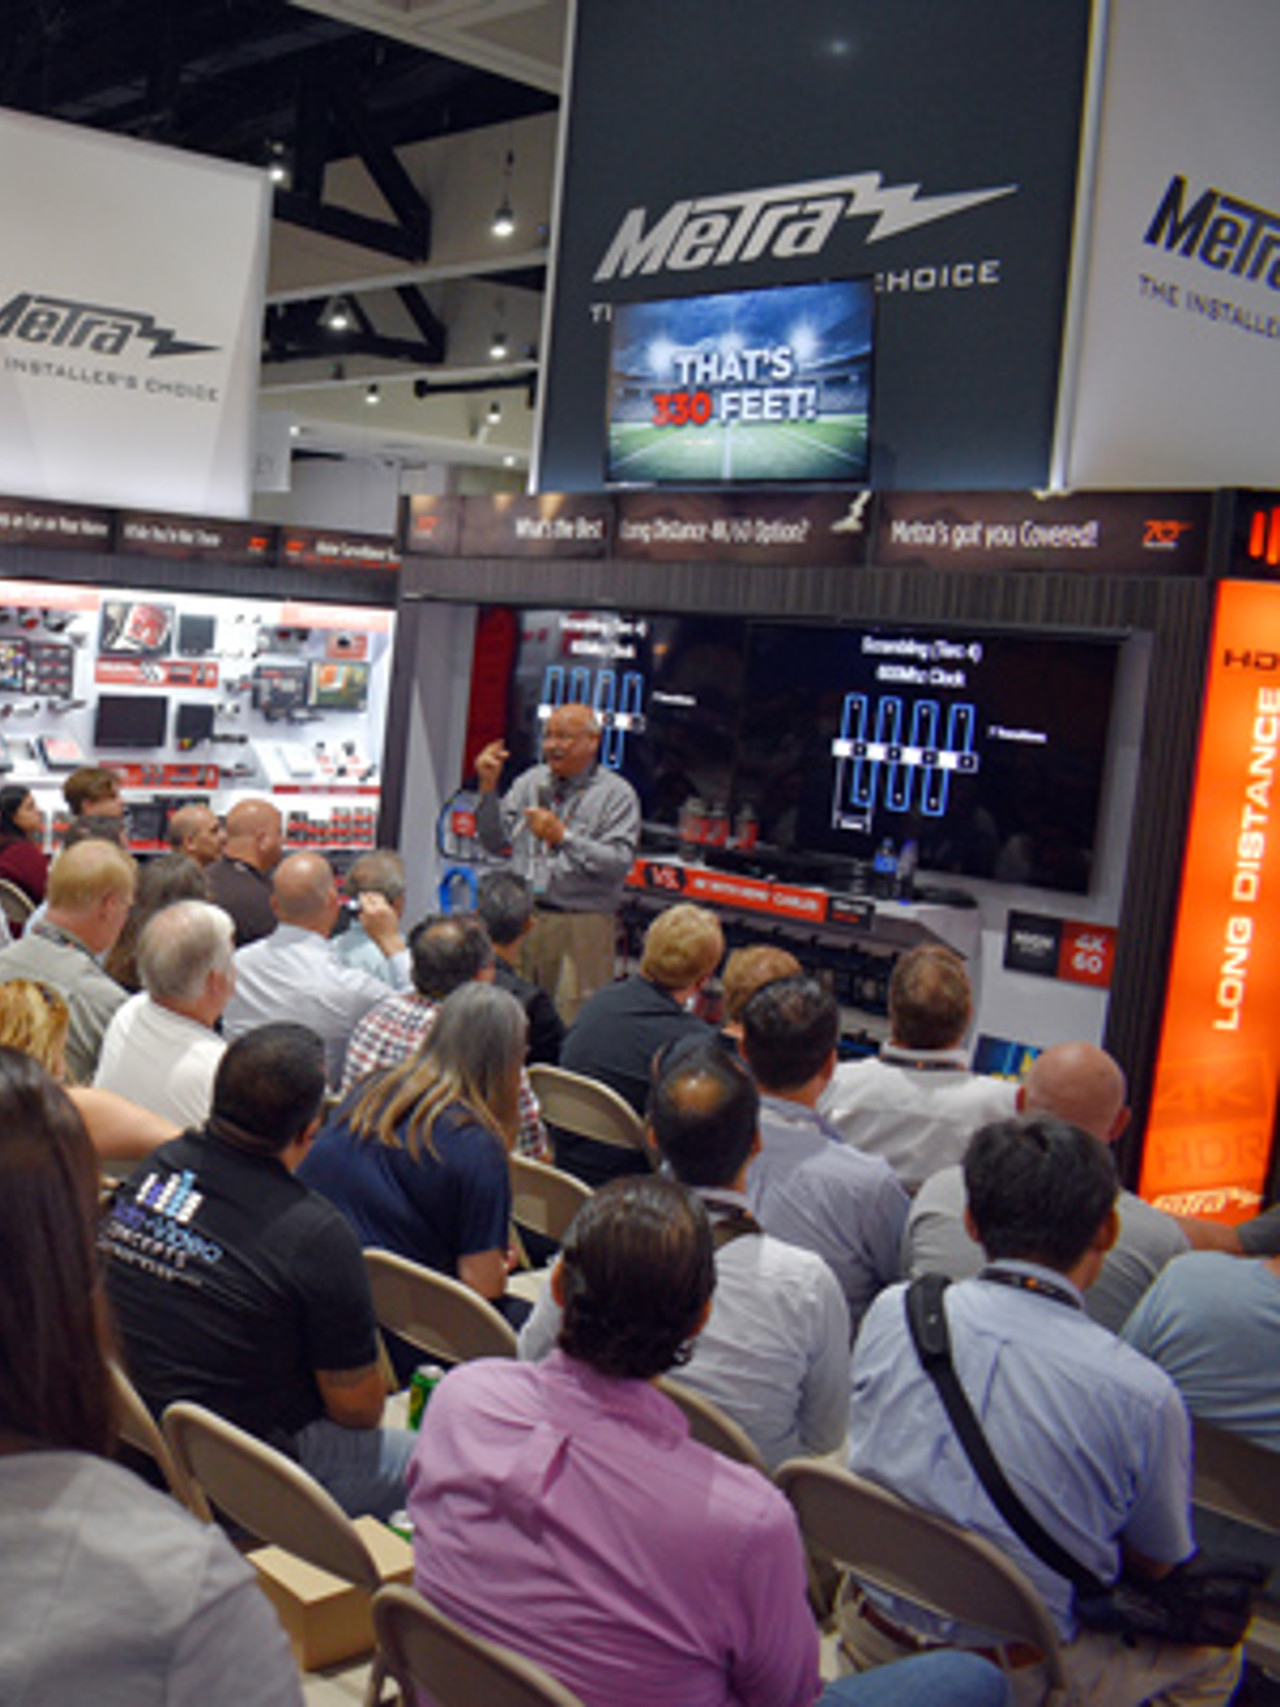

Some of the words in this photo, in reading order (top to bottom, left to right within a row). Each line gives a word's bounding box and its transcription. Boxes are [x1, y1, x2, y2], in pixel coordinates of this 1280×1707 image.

[593, 172, 883, 282] Metra
[1139, 273, 1180, 308] THE
[1186, 291, 1280, 339] INSTALLE
[4, 358, 137, 391] INSTALLER'S
[145, 378, 219, 402] CHOICE
[674, 346, 792, 386] THAT'S
[652, 391, 713, 427] 330
[719, 387, 817, 423] FEET!
[891, 520, 948, 544] Metra's
[952, 521, 983, 548] got
[985, 523, 1017, 548] you
[1224, 648, 1280, 672] HD
[1232, 686, 1280, 902] DISTANCE
[1071, 951, 1103, 975] 60
[1075, 933, 1107, 956] 4K
[1212, 914, 1254, 1032] LONG
[1155, 1131, 1265, 1178] HDR
